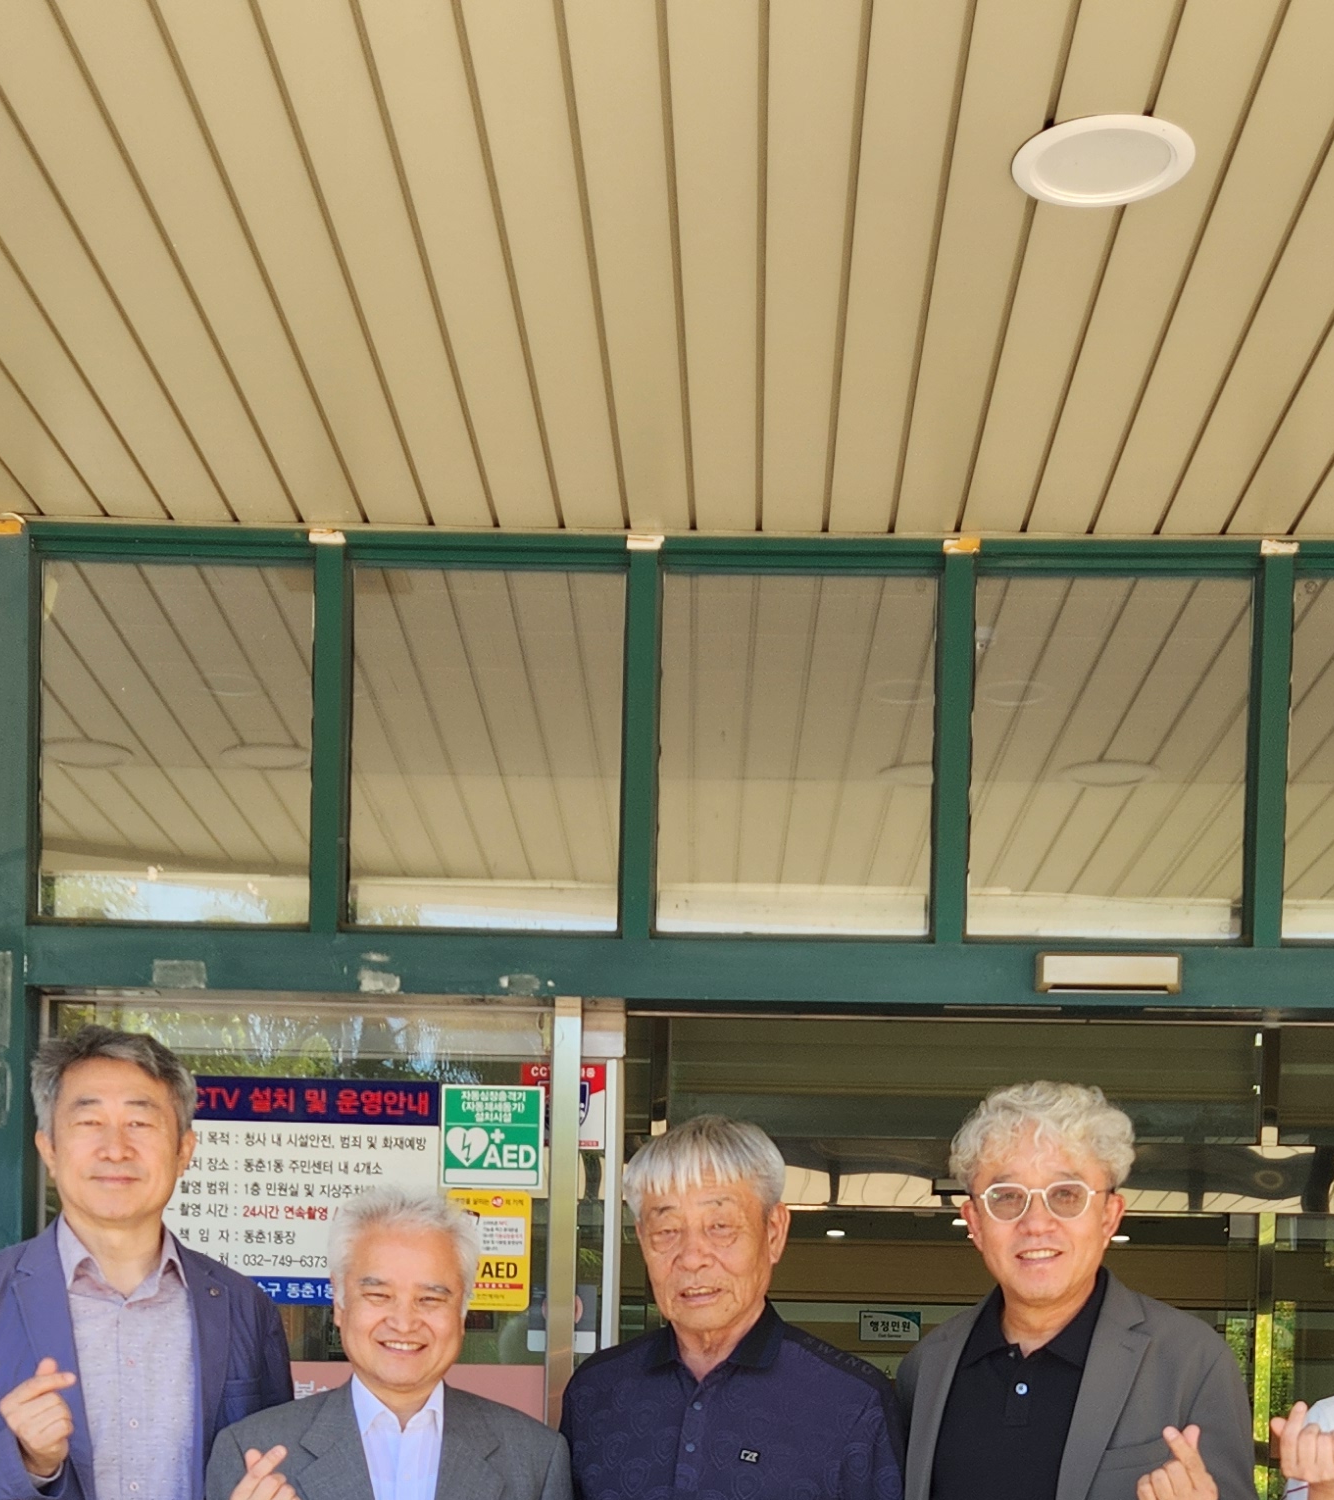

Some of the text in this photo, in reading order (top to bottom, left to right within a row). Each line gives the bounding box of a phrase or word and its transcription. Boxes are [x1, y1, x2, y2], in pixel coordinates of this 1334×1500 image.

[248, 1088, 296, 1115] 설치
[336, 1090, 430, 1117] 운영안내
[207, 1131, 230, 1146] 목적
[244, 1132, 266, 1147] 청사
[271, 1133, 283, 1147] 내
[340, 1134, 362, 1149] 범죄
[366, 1135, 378, 1149] 및
[381, 1135, 428, 1152] 화재예방
[482, 1144, 537, 1169] AED
[207, 1158, 383, 1176] 장소 동춘1동 주민센터 내 4개소
[179, 1181, 316, 1198] 촬영 범위 1층 민원실 및
[179, 1203, 329, 1222] 촬영 시간 24시간 연속촬영
[243, 1229, 297, 1245] 동춘1동장
[242, 1254, 329, 1269] 032-749-6373
[480, 1261, 519, 1279] AED
[869, 1320, 911, 1333] 행정민원
